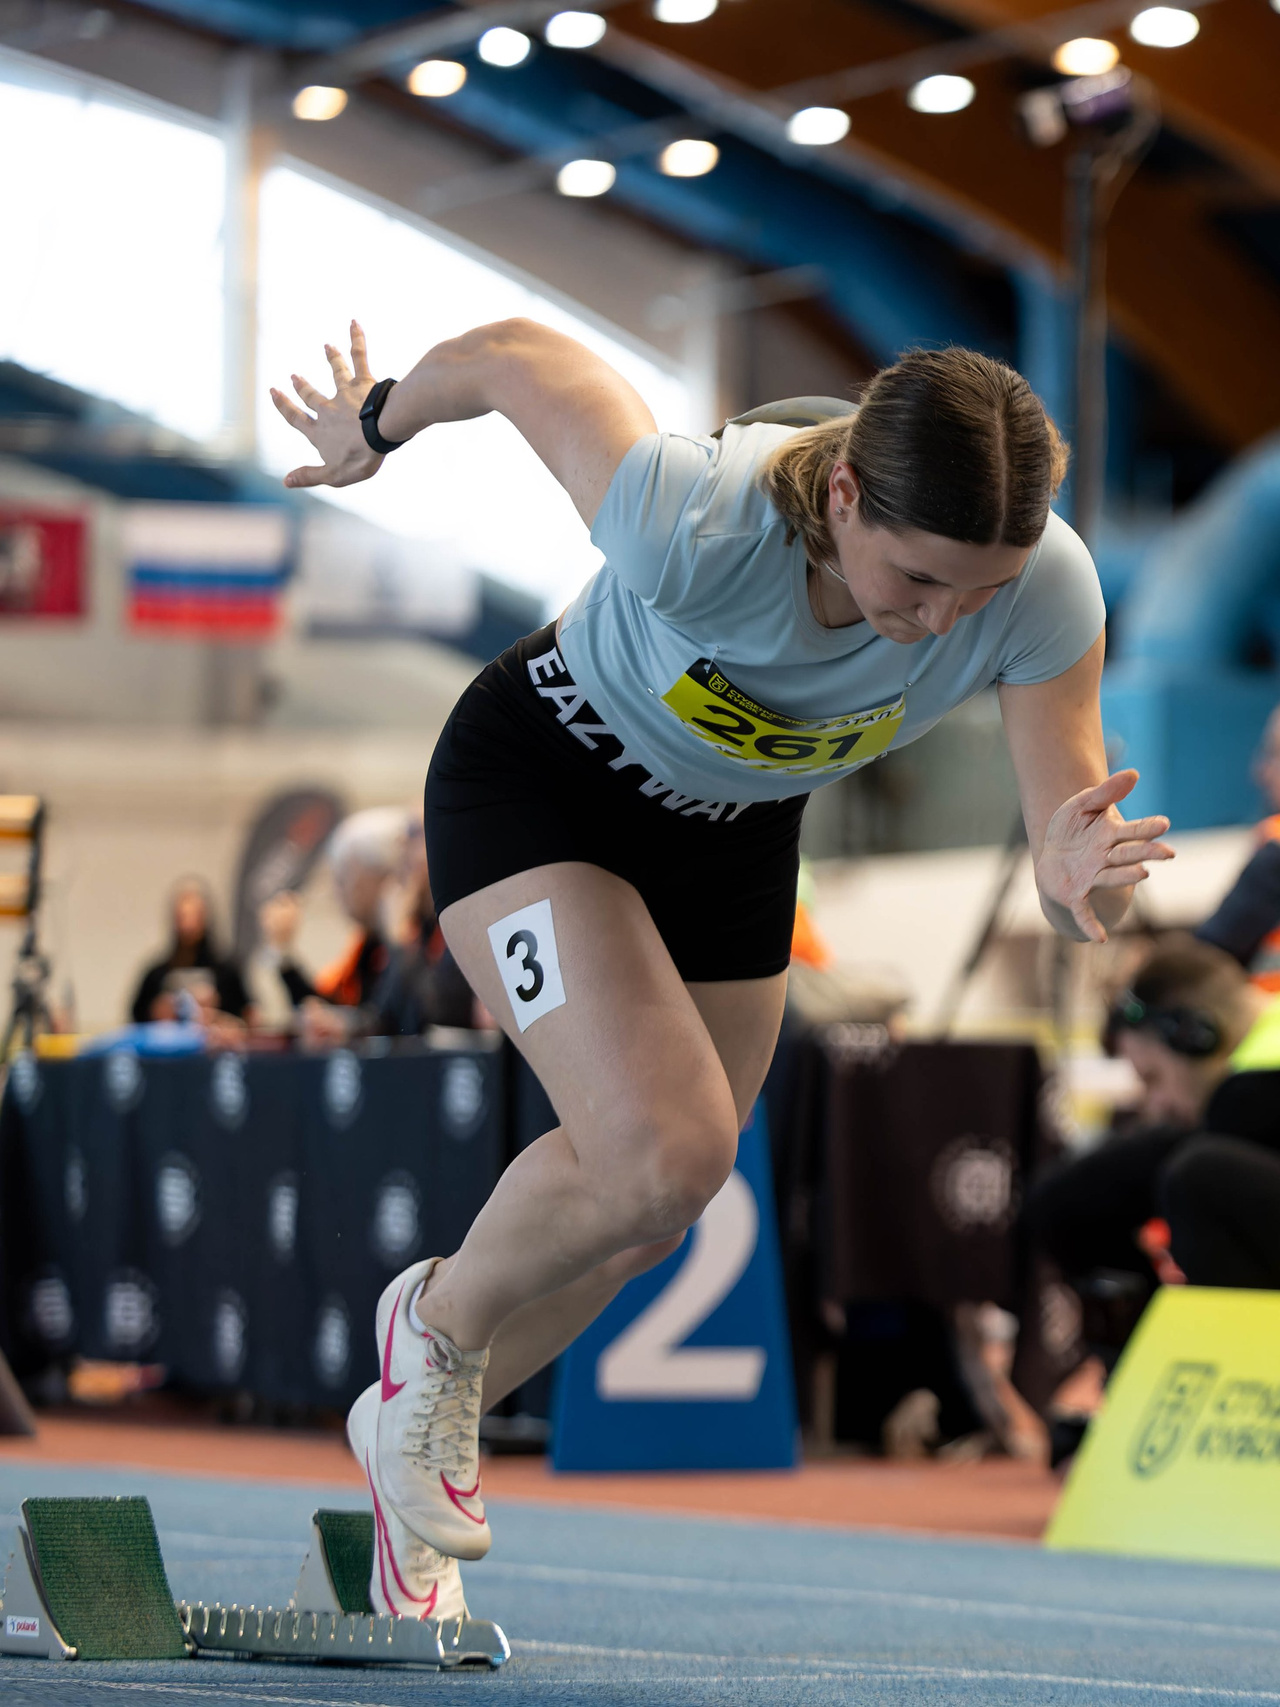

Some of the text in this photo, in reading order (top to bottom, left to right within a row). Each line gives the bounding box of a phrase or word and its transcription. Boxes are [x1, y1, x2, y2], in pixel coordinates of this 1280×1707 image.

[691, 704, 865, 760] 261
[505, 928, 545, 1003] 3
[595, 1164, 768, 1403] 2
